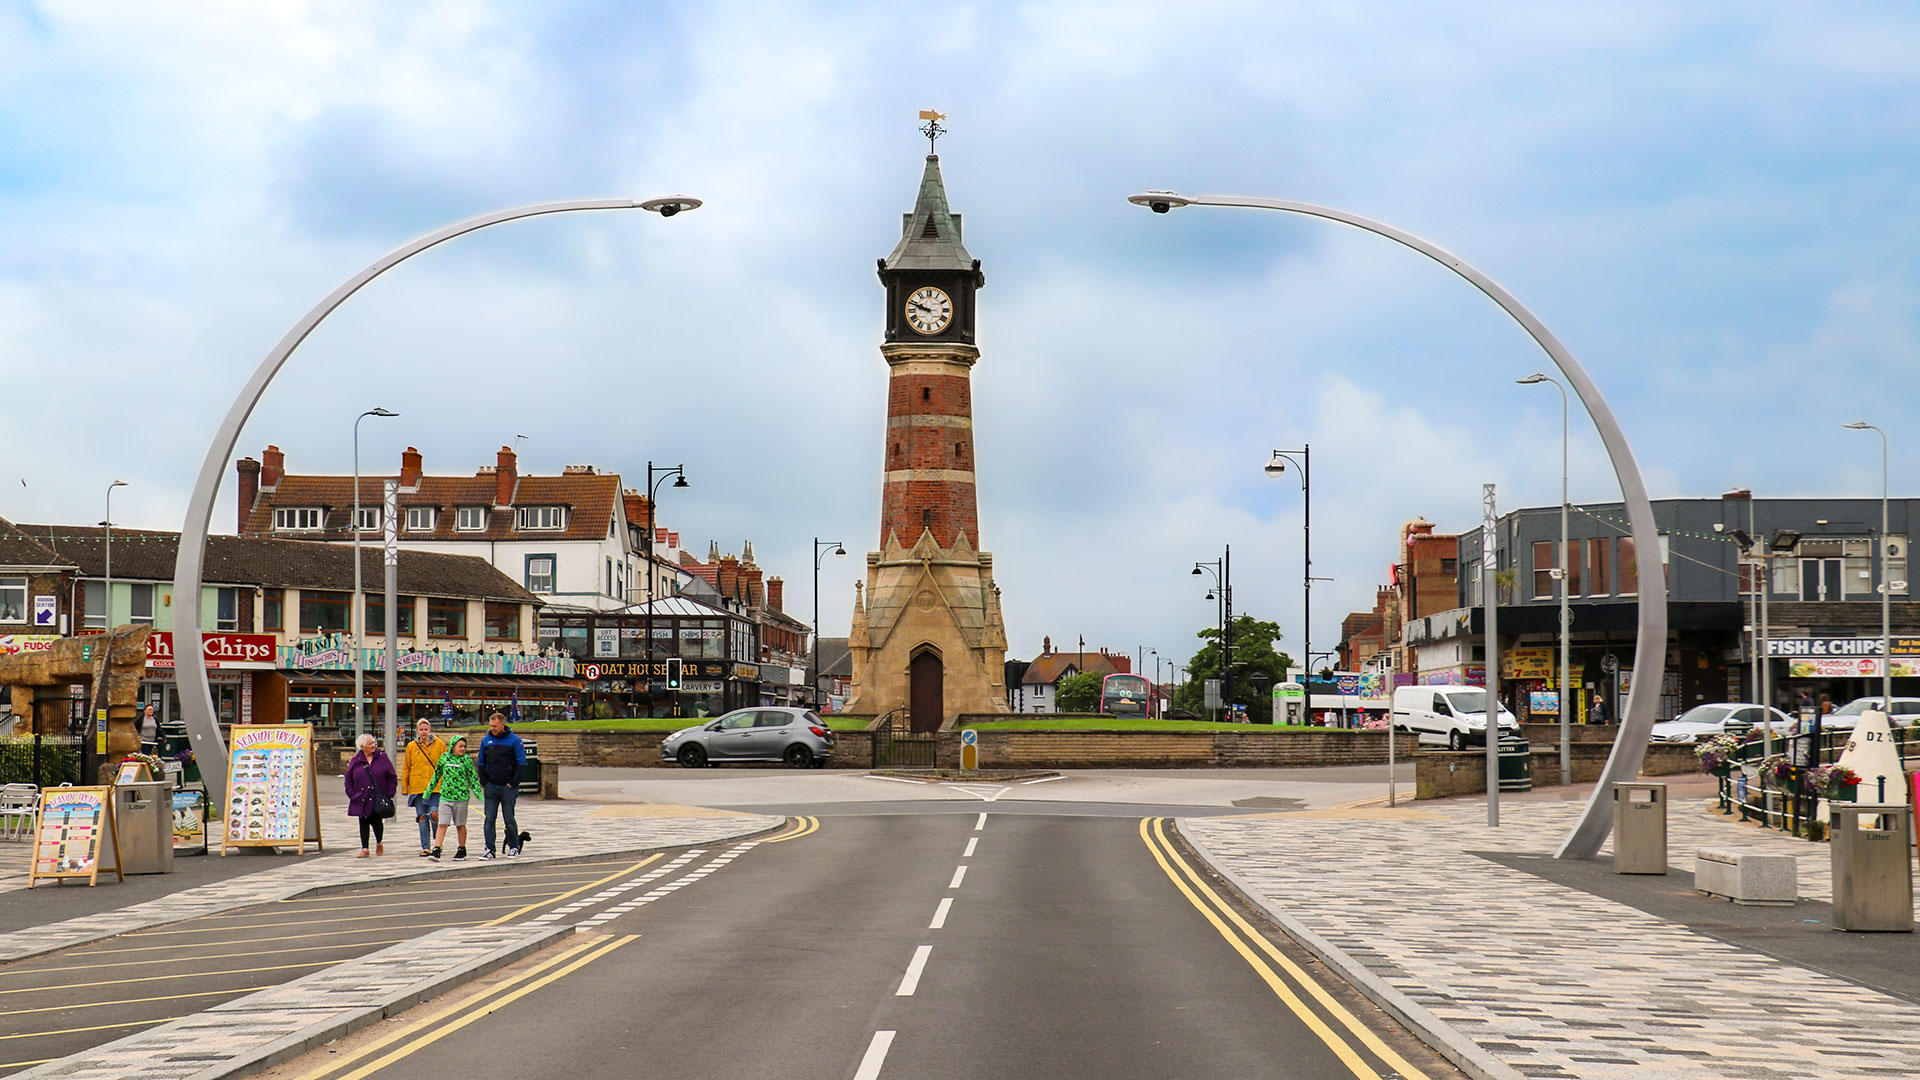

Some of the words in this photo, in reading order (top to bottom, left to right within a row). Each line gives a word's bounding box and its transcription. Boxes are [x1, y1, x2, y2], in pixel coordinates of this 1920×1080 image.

[24, 642, 51, 650] FUDG
[147, 634, 173, 656] sh
[203, 636, 270, 661] Chips
[1767, 640, 1809, 654] FISH
[1812, 640, 1827, 654] &
[1829, 640, 1885, 655] CHIPS
[304, 658, 317, 667] FISH
[322, 651, 338, 662] CHIPS
[402, 653, 421, 665] MEALS
[453, 658, 467, 667] FISH
[469, 659, 474, 667] &
[475, 658, 495, 668] CHIPS
[599, 664, 624, 675] OAT
[682, 664, 698, 675] AR
[1514, 669, 1522, 677] 7
[1825, 668, 1848, 676] Chips
[236, 731, 273, 748] SEASIDE
[276, 730, 305, 748] TREATS
[49, 793, 75, 807] SEASIDE
[78, 793, 99, 805] TREATS
[1866, 833, 1890, 841] Litter
